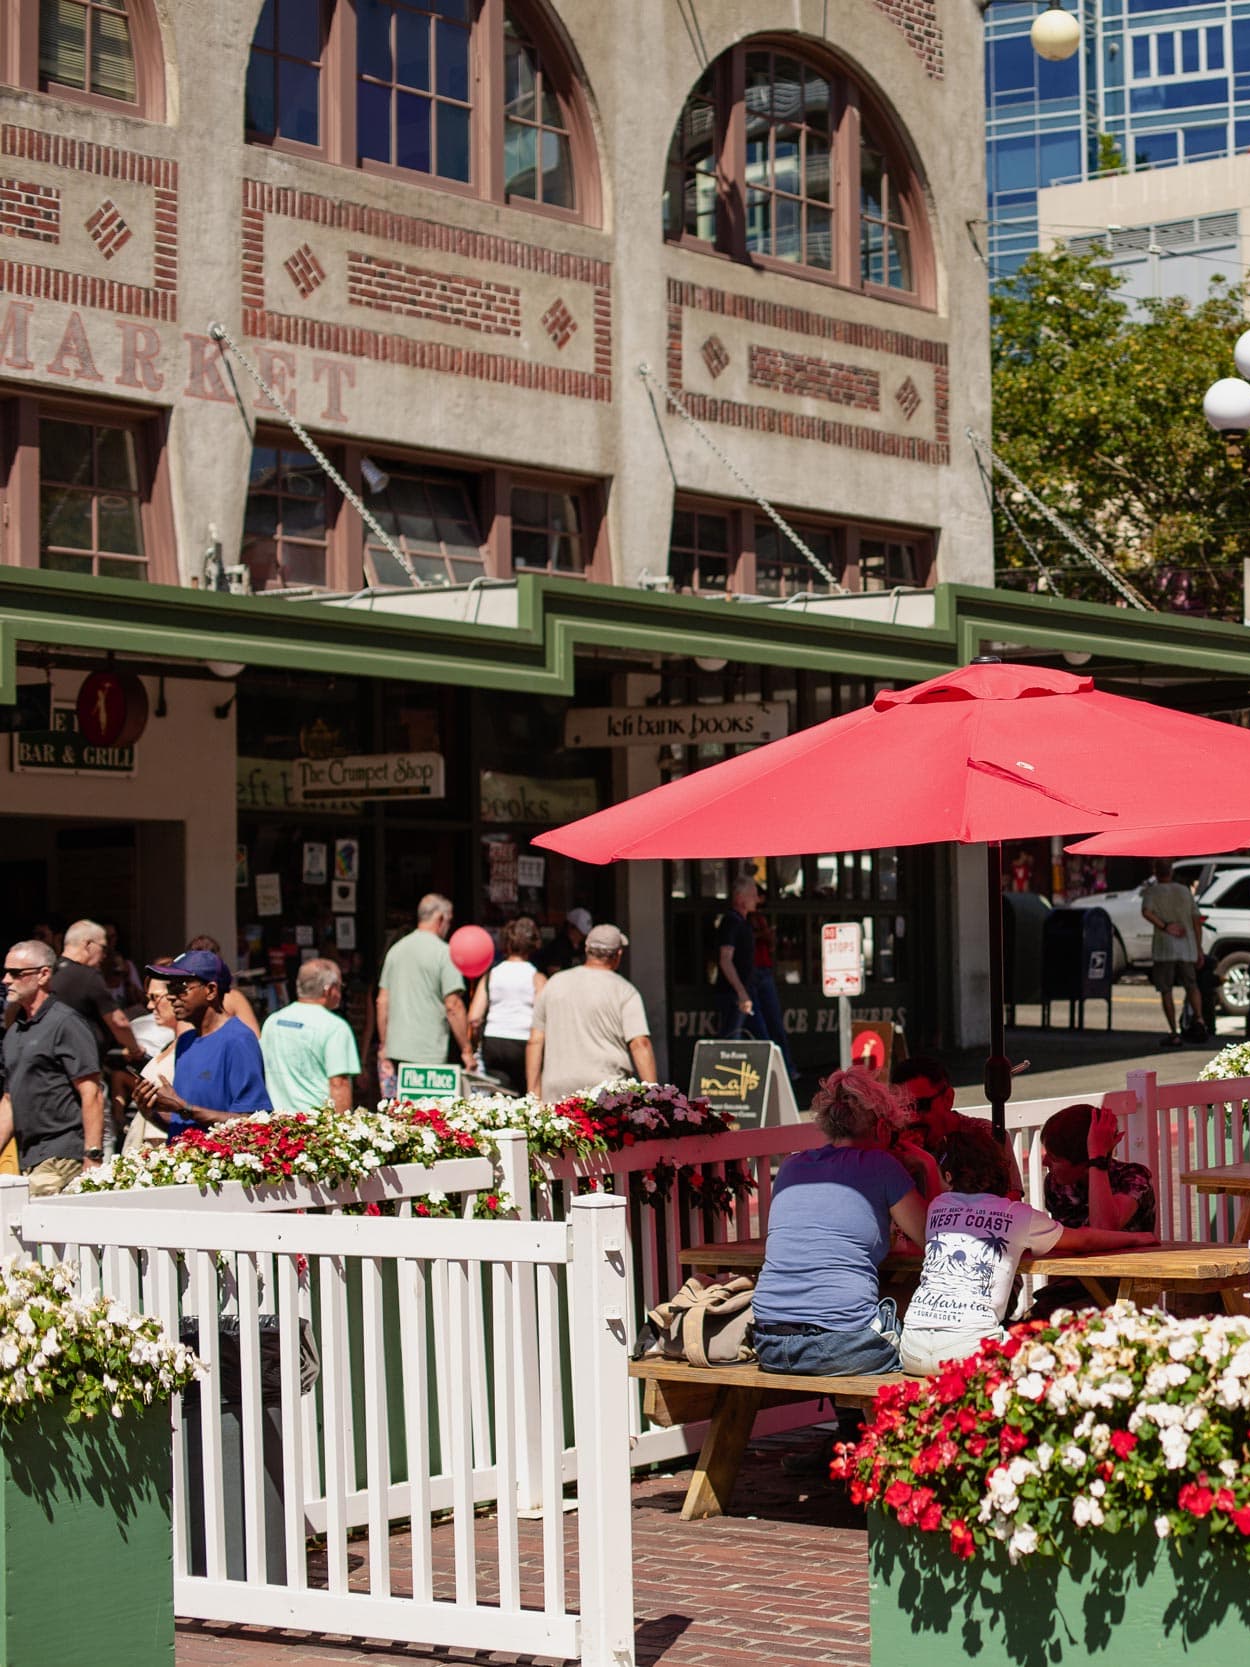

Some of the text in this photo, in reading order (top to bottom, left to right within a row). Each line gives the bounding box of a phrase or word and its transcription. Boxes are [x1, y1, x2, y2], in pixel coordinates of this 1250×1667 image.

[637, 714, 685, 735] bank
[688, 713, 754, 739] books
[20, 742, 134, 768] BAR & GRILL
[299, 757, 433, 789] The Crumpet Shop
[674, 1011, 721, 1036] PIK
[404, 1069, 454, 1089] Pike Place
[930, 1213, 1013, 1233] WEST COAST
[976, 1208, 987, 1216] LOS
